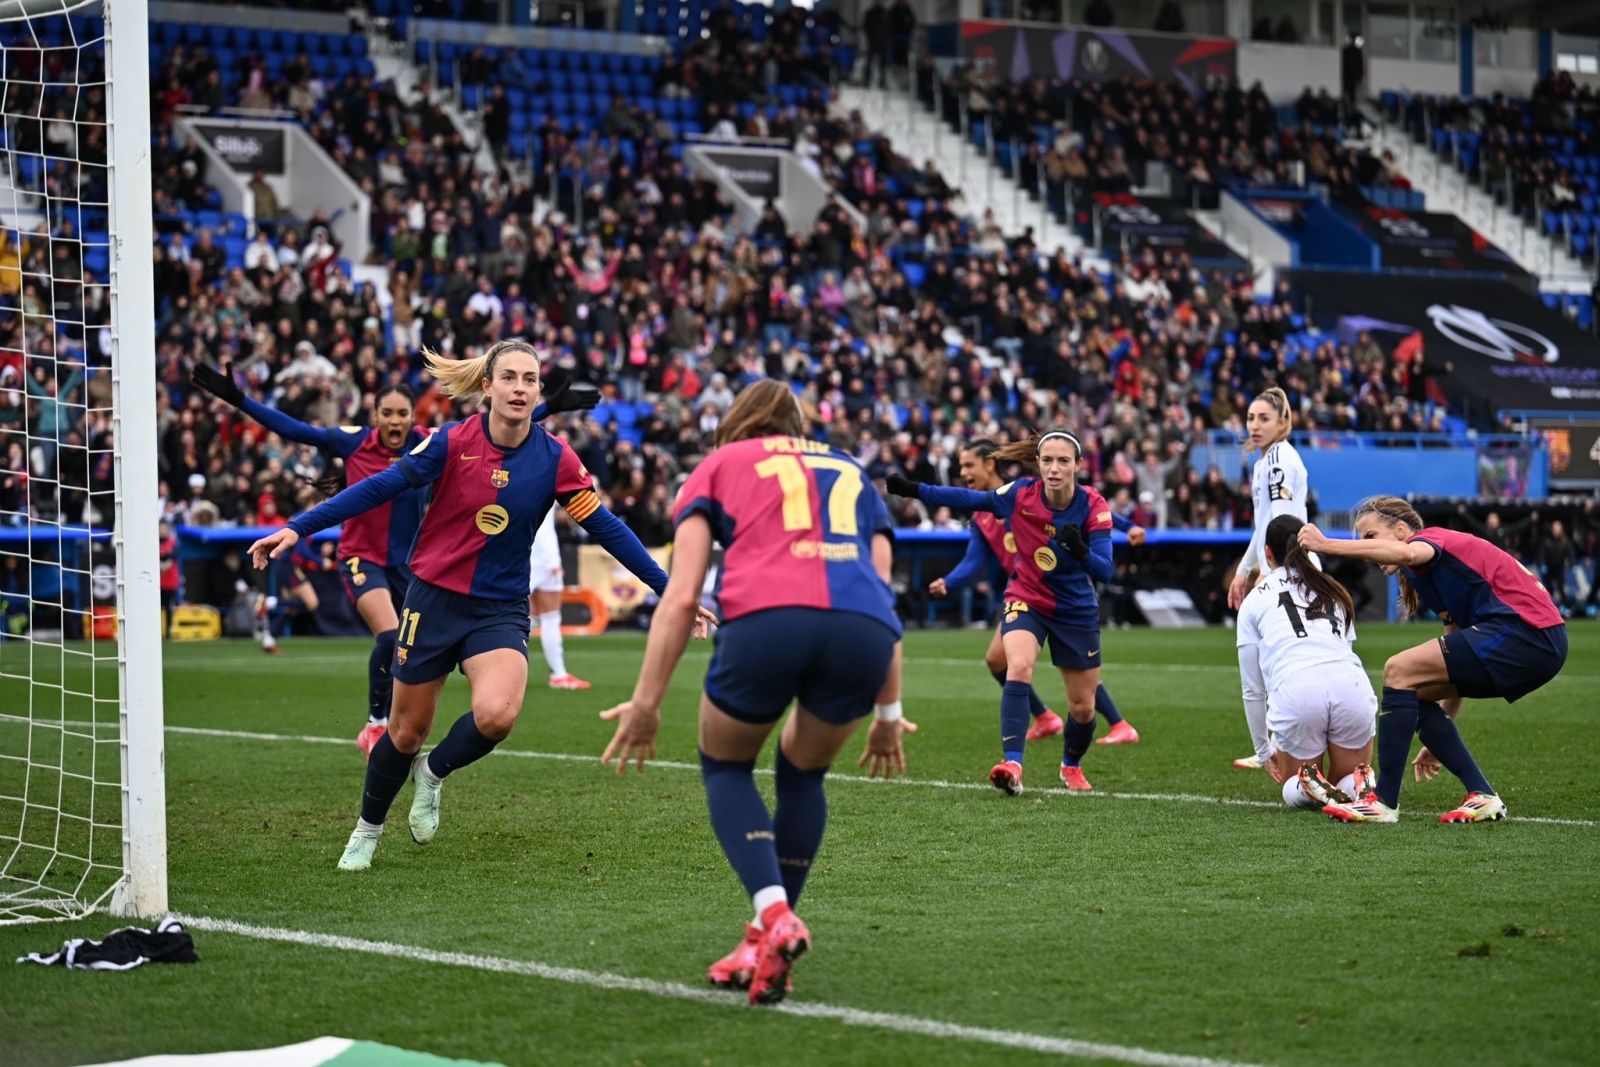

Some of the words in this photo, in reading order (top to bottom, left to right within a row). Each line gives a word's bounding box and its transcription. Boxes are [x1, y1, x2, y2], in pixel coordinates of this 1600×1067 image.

[754, 454, 864, 536] 17
[346, 557, 360, 575] 7
[398, 608, 421, 646] 11
[1277, 590, 1343, 639] 14
